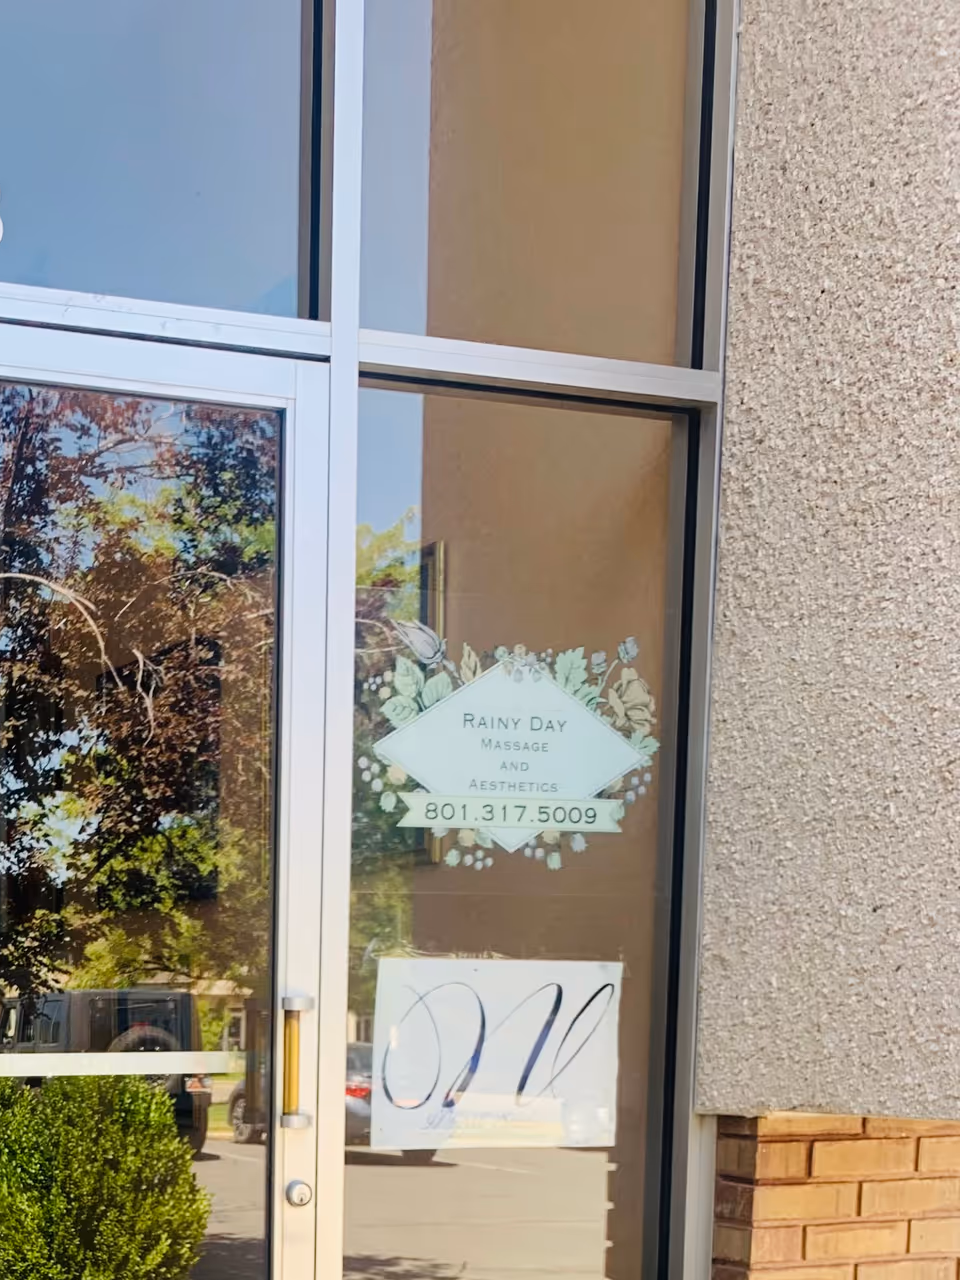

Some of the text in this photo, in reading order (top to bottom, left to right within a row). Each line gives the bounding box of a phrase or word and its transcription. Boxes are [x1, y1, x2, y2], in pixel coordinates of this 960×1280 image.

[463, 713, 567, 733] RAINY DAY
[481, 738, 549, 753] MASSAGE
[500, 761, 530, 773] AND
[468, 778, 559, 794] AESTHETICS
[425, 802, 597, 825] 801.317.5009
